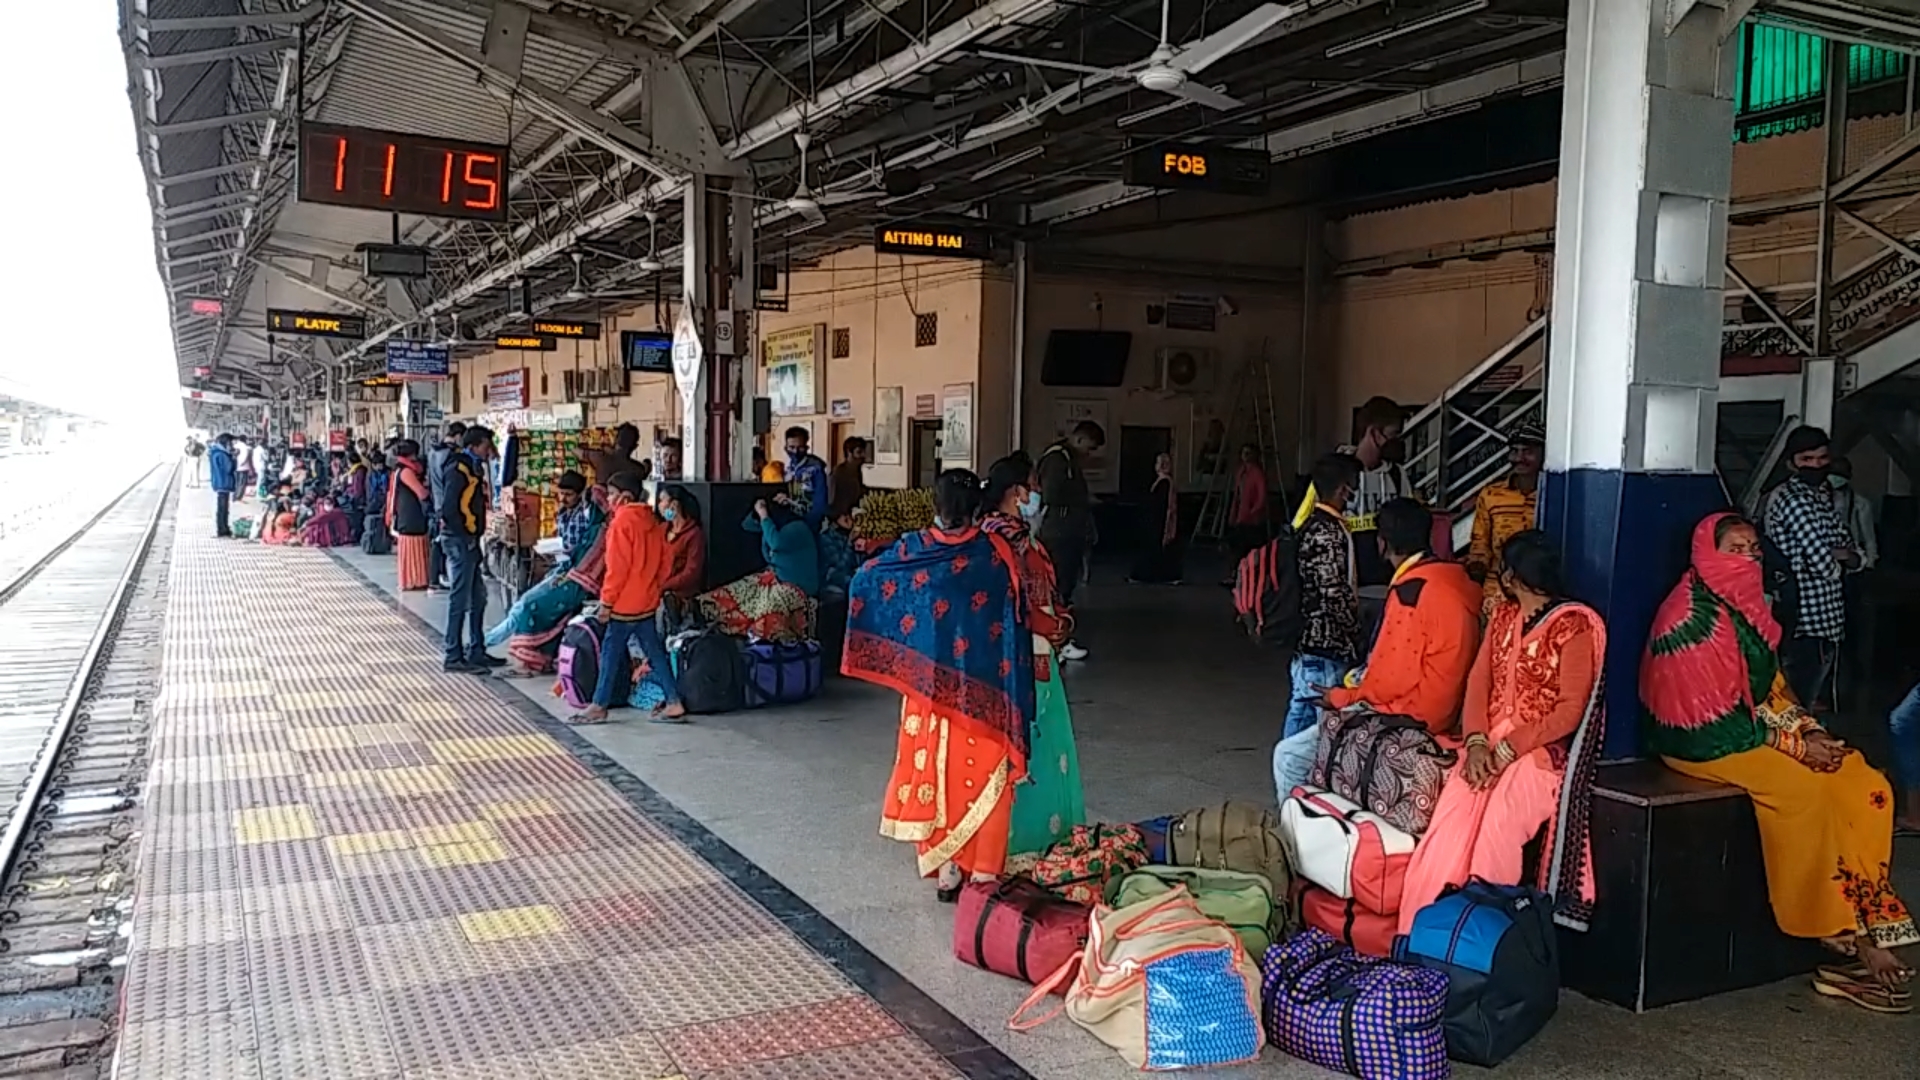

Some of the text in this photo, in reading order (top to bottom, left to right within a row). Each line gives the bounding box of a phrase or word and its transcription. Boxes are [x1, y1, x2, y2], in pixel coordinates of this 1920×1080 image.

[334, 138, 497, 209] 11 15
[1165, 153, 1206, 176] FOB
[884, 230, 962, 248] AITING HAI
[718, 326, 729, 337] 19
